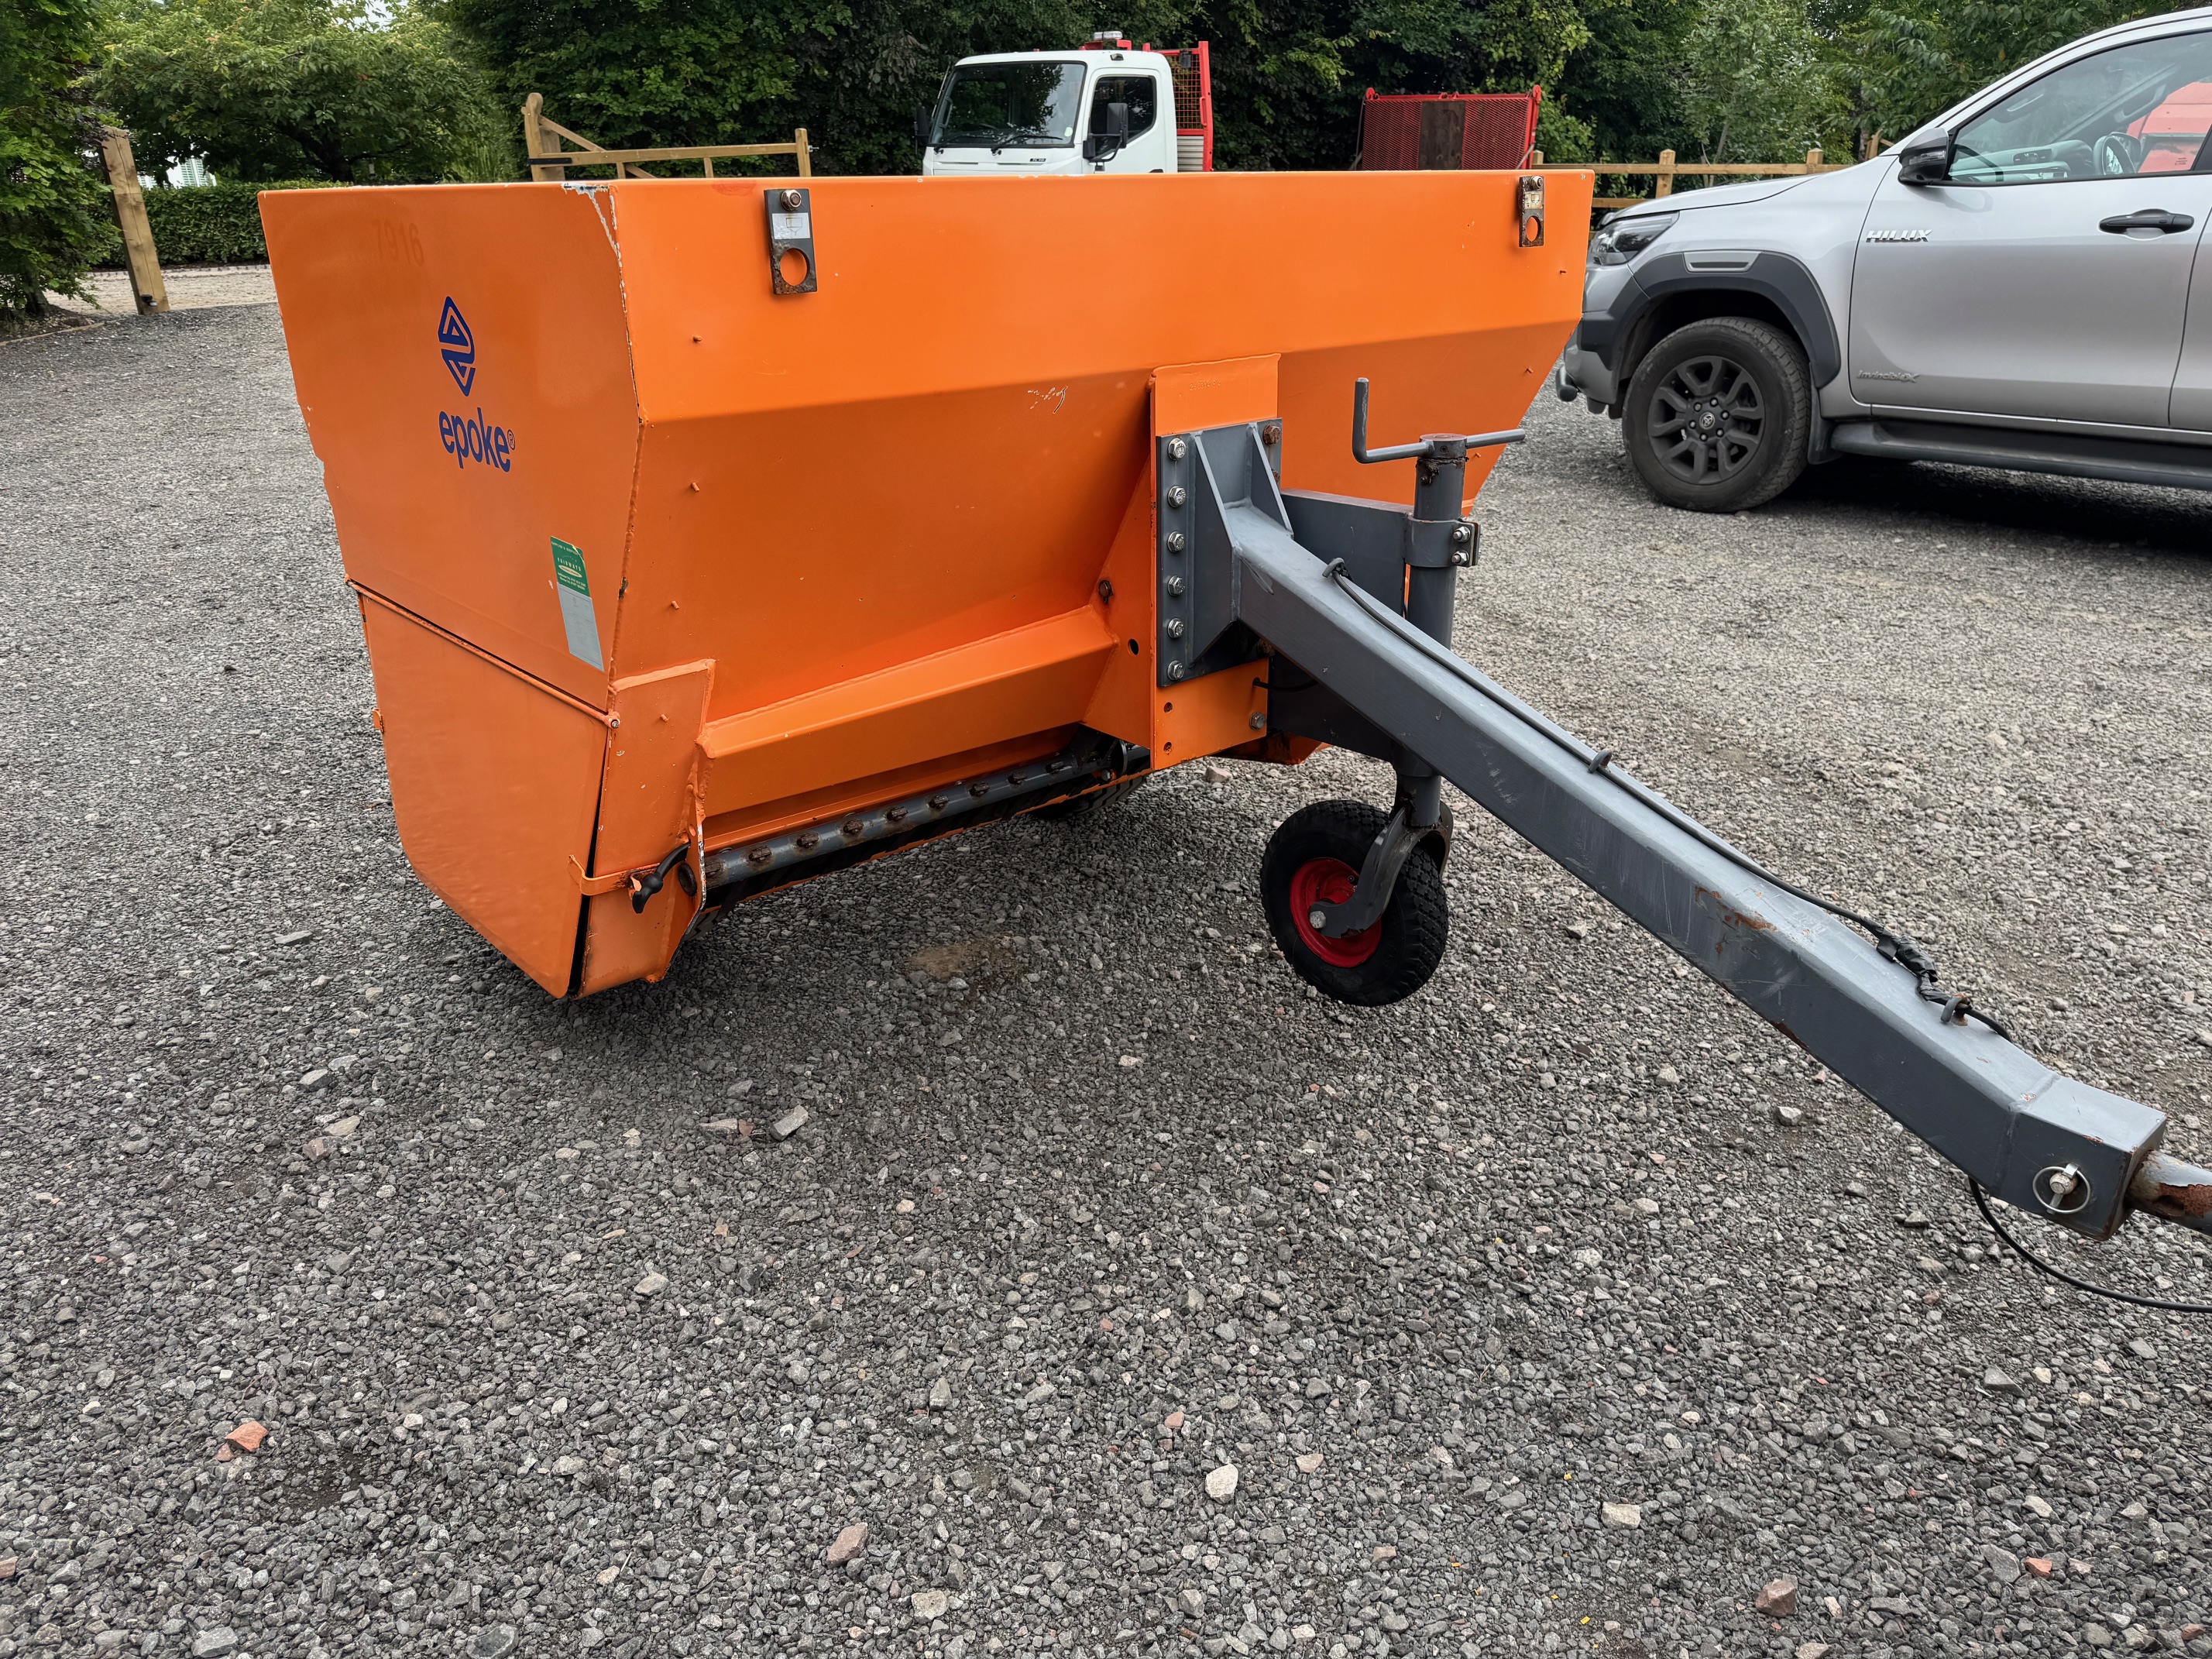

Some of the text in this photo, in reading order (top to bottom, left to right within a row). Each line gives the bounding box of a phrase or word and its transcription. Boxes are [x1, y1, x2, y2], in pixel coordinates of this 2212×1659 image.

[371, 218, 424, 267] 7916
[1866, 229, 1932, 242] HILUX
[558, 557, 581, 572] FAIRWAYS
